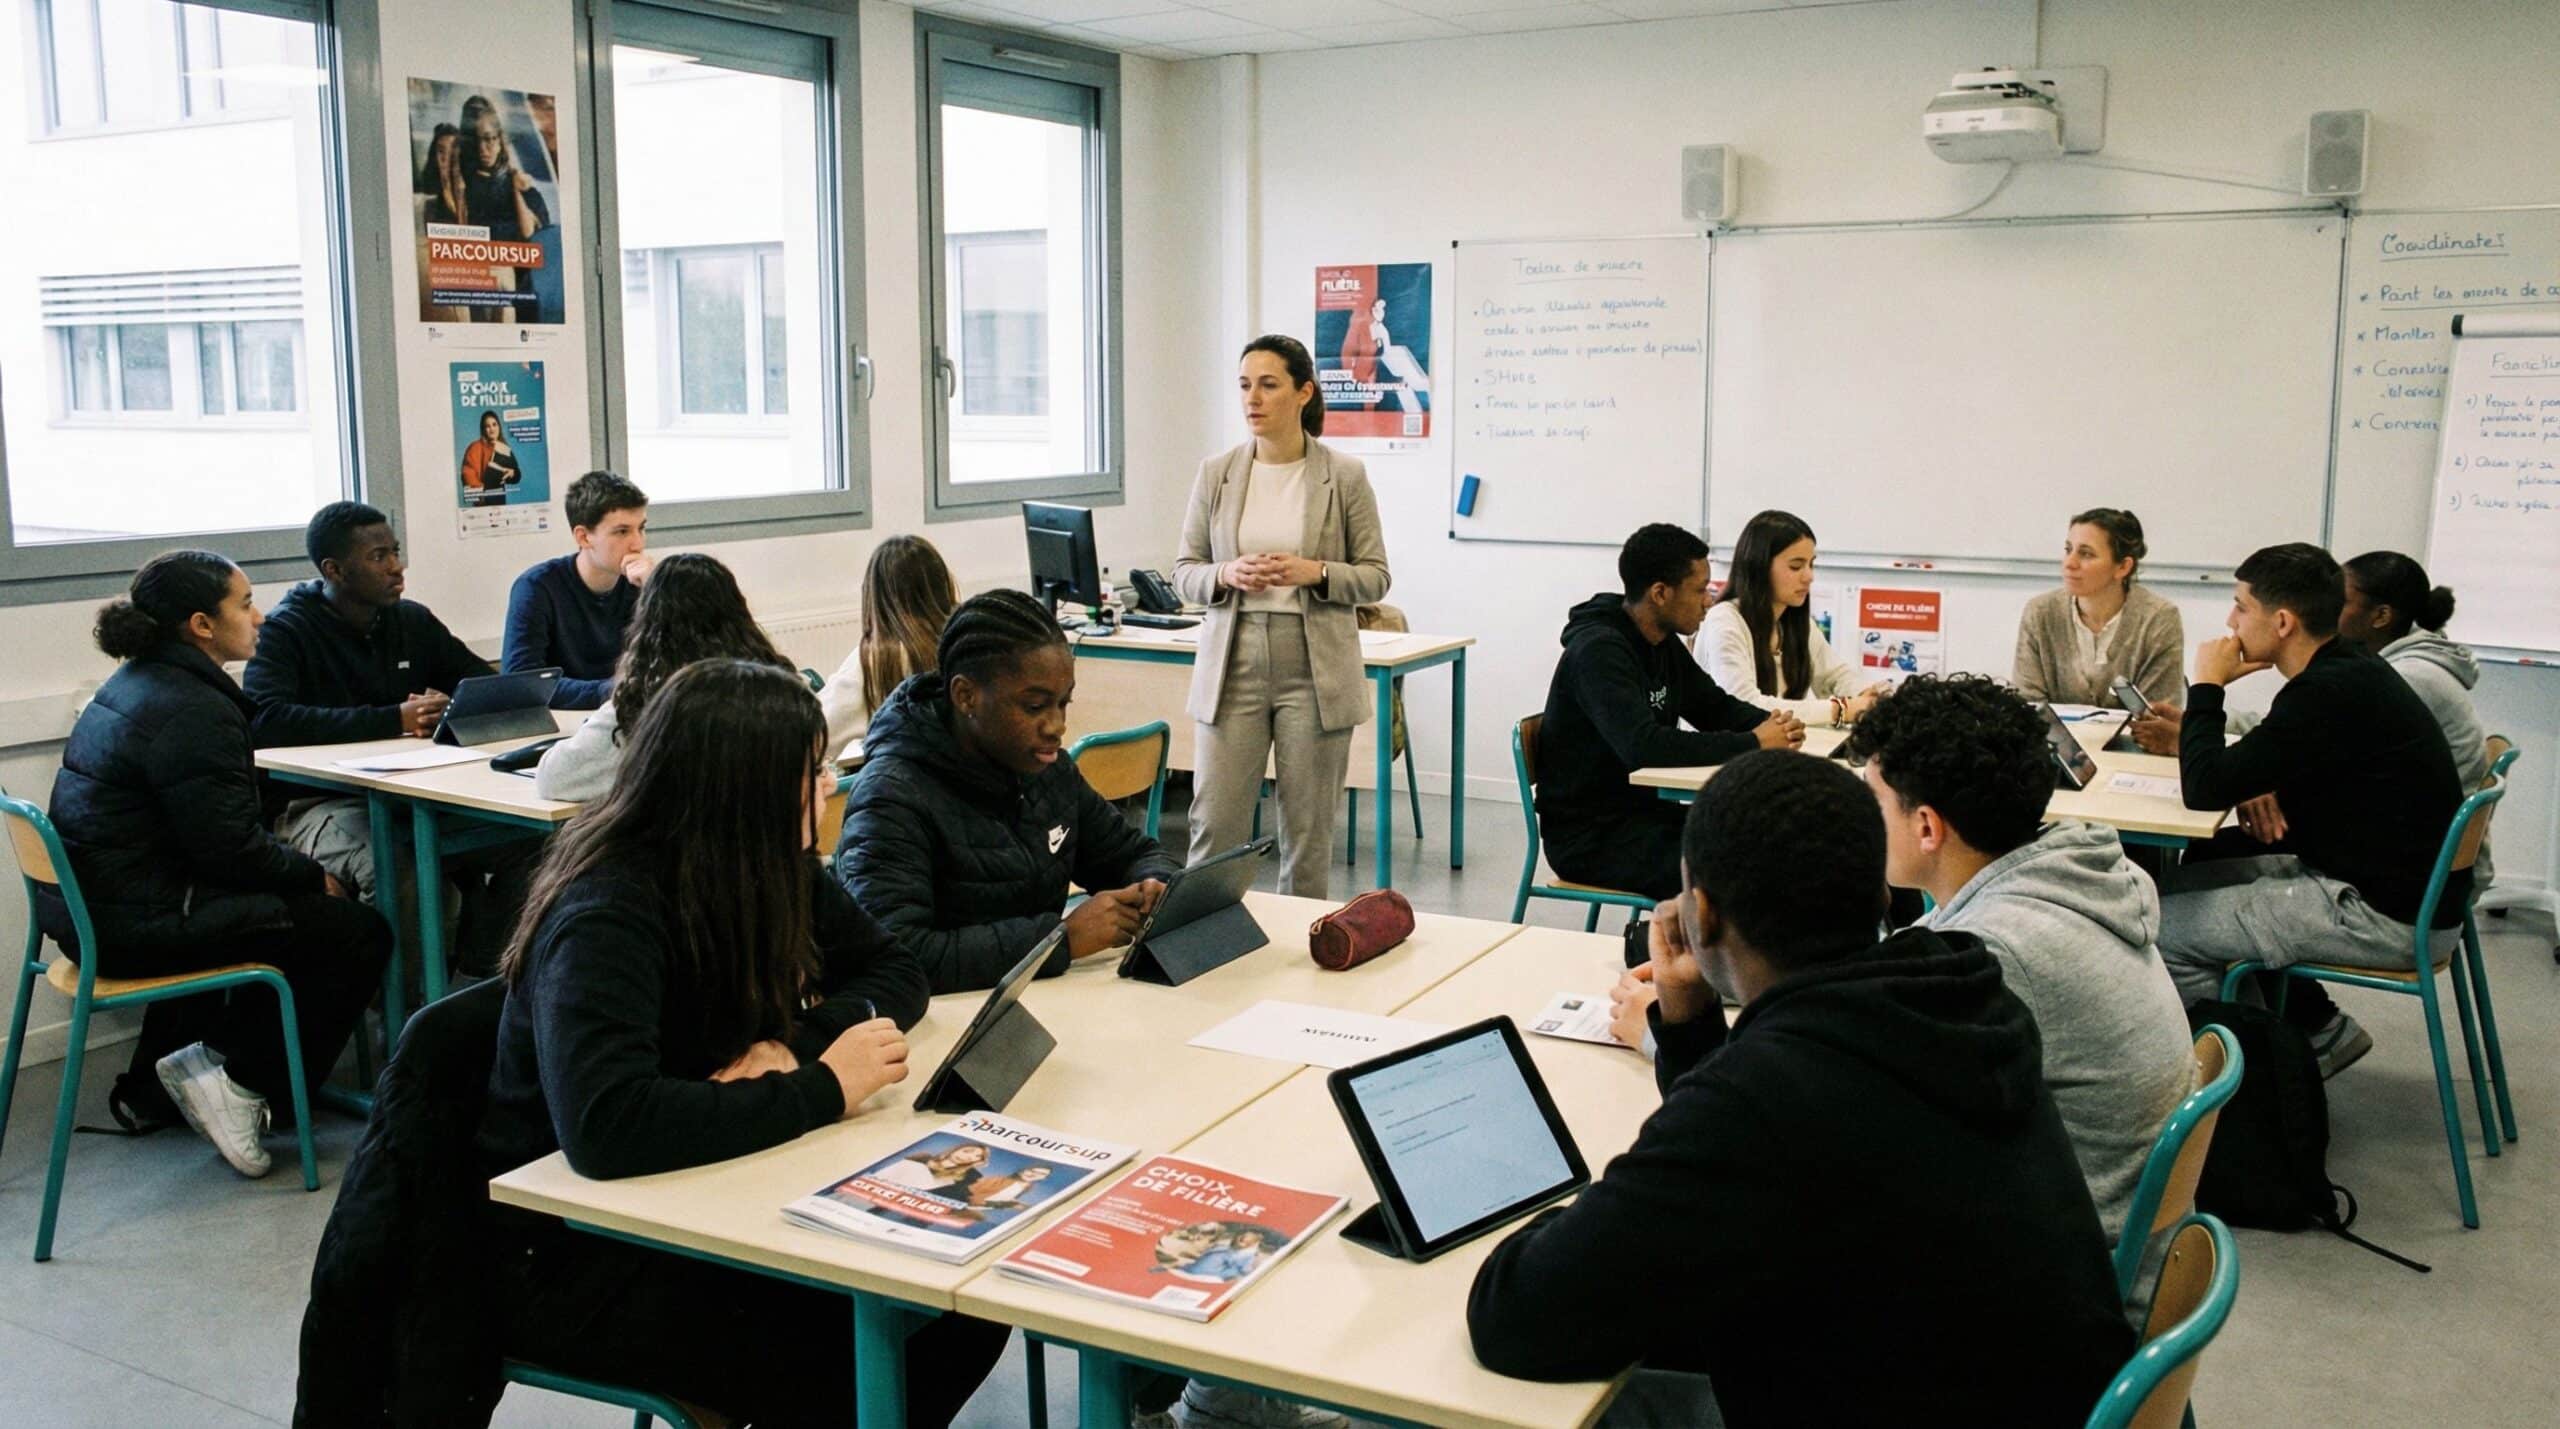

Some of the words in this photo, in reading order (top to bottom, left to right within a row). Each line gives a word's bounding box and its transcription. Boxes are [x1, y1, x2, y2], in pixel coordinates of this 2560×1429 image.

[432, 243, 540, 263] PARCOURSUP
[462, 395, 477, 407] DE
[973, 1120, 1111, 1161] parcoursup
[1147, 1165, 1234, 1195] CHOIX
[1132, 1176, 1171, 1193] DE
[1170, 1184, 1265, 1217] FILIÈRE
